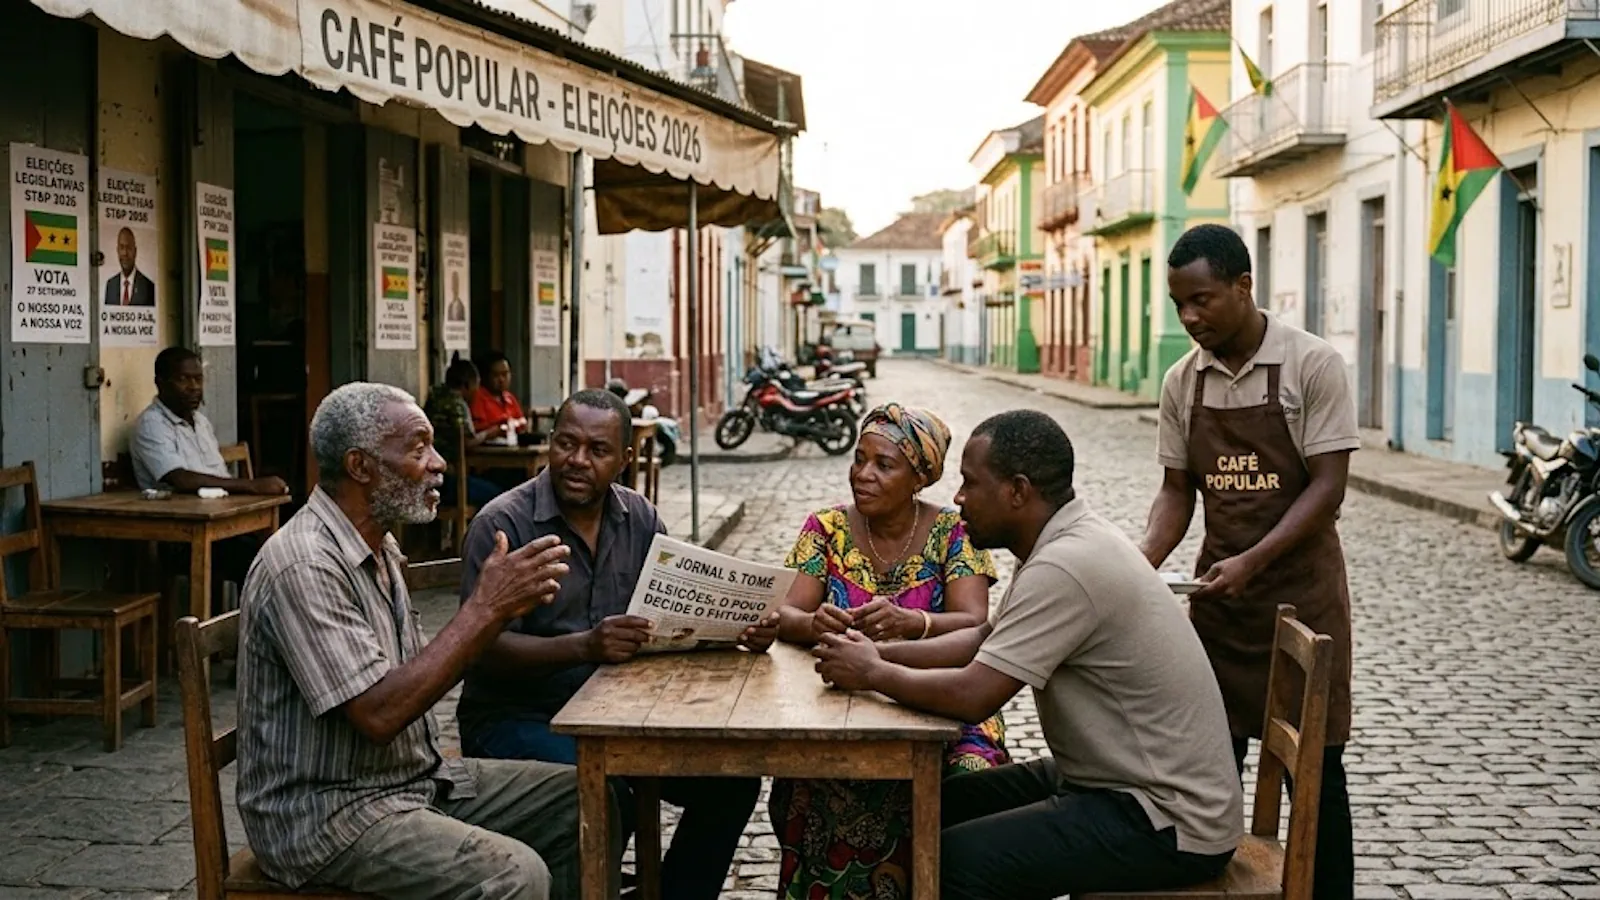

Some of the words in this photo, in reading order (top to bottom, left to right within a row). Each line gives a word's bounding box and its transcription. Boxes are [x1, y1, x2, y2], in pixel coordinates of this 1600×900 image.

[321, 8, 407, 87] CAFÉ
[415, 37, 541, 121] POPULAR
[562, 82, 657, 153] ELEIÇÕES
[661, 114, 701, 163] 2026
[34, 268, 70, 285] VOTA
[27, 286, 36, 295] 27
[17, 302, 25, 312] O
[28, 302, 60, 314] NOSSO
[101, 312, 108, 321] O
[20, 318, 28, 328] A
[30, 318, 62, 329] NOSSA
[1217, 451, 1259, 472] CAFÉ
[1205, 472, 1281, 490] POPULAR
[675, 557, 724, 580] JORNAL
[727, 570, 738, 584] S.
[741, 572, 775, 589] TOMÉ
[644, 593, 693, 615] DECIDE
[694, 606, 705, 617] O
[719, 597, 729, 607] O
